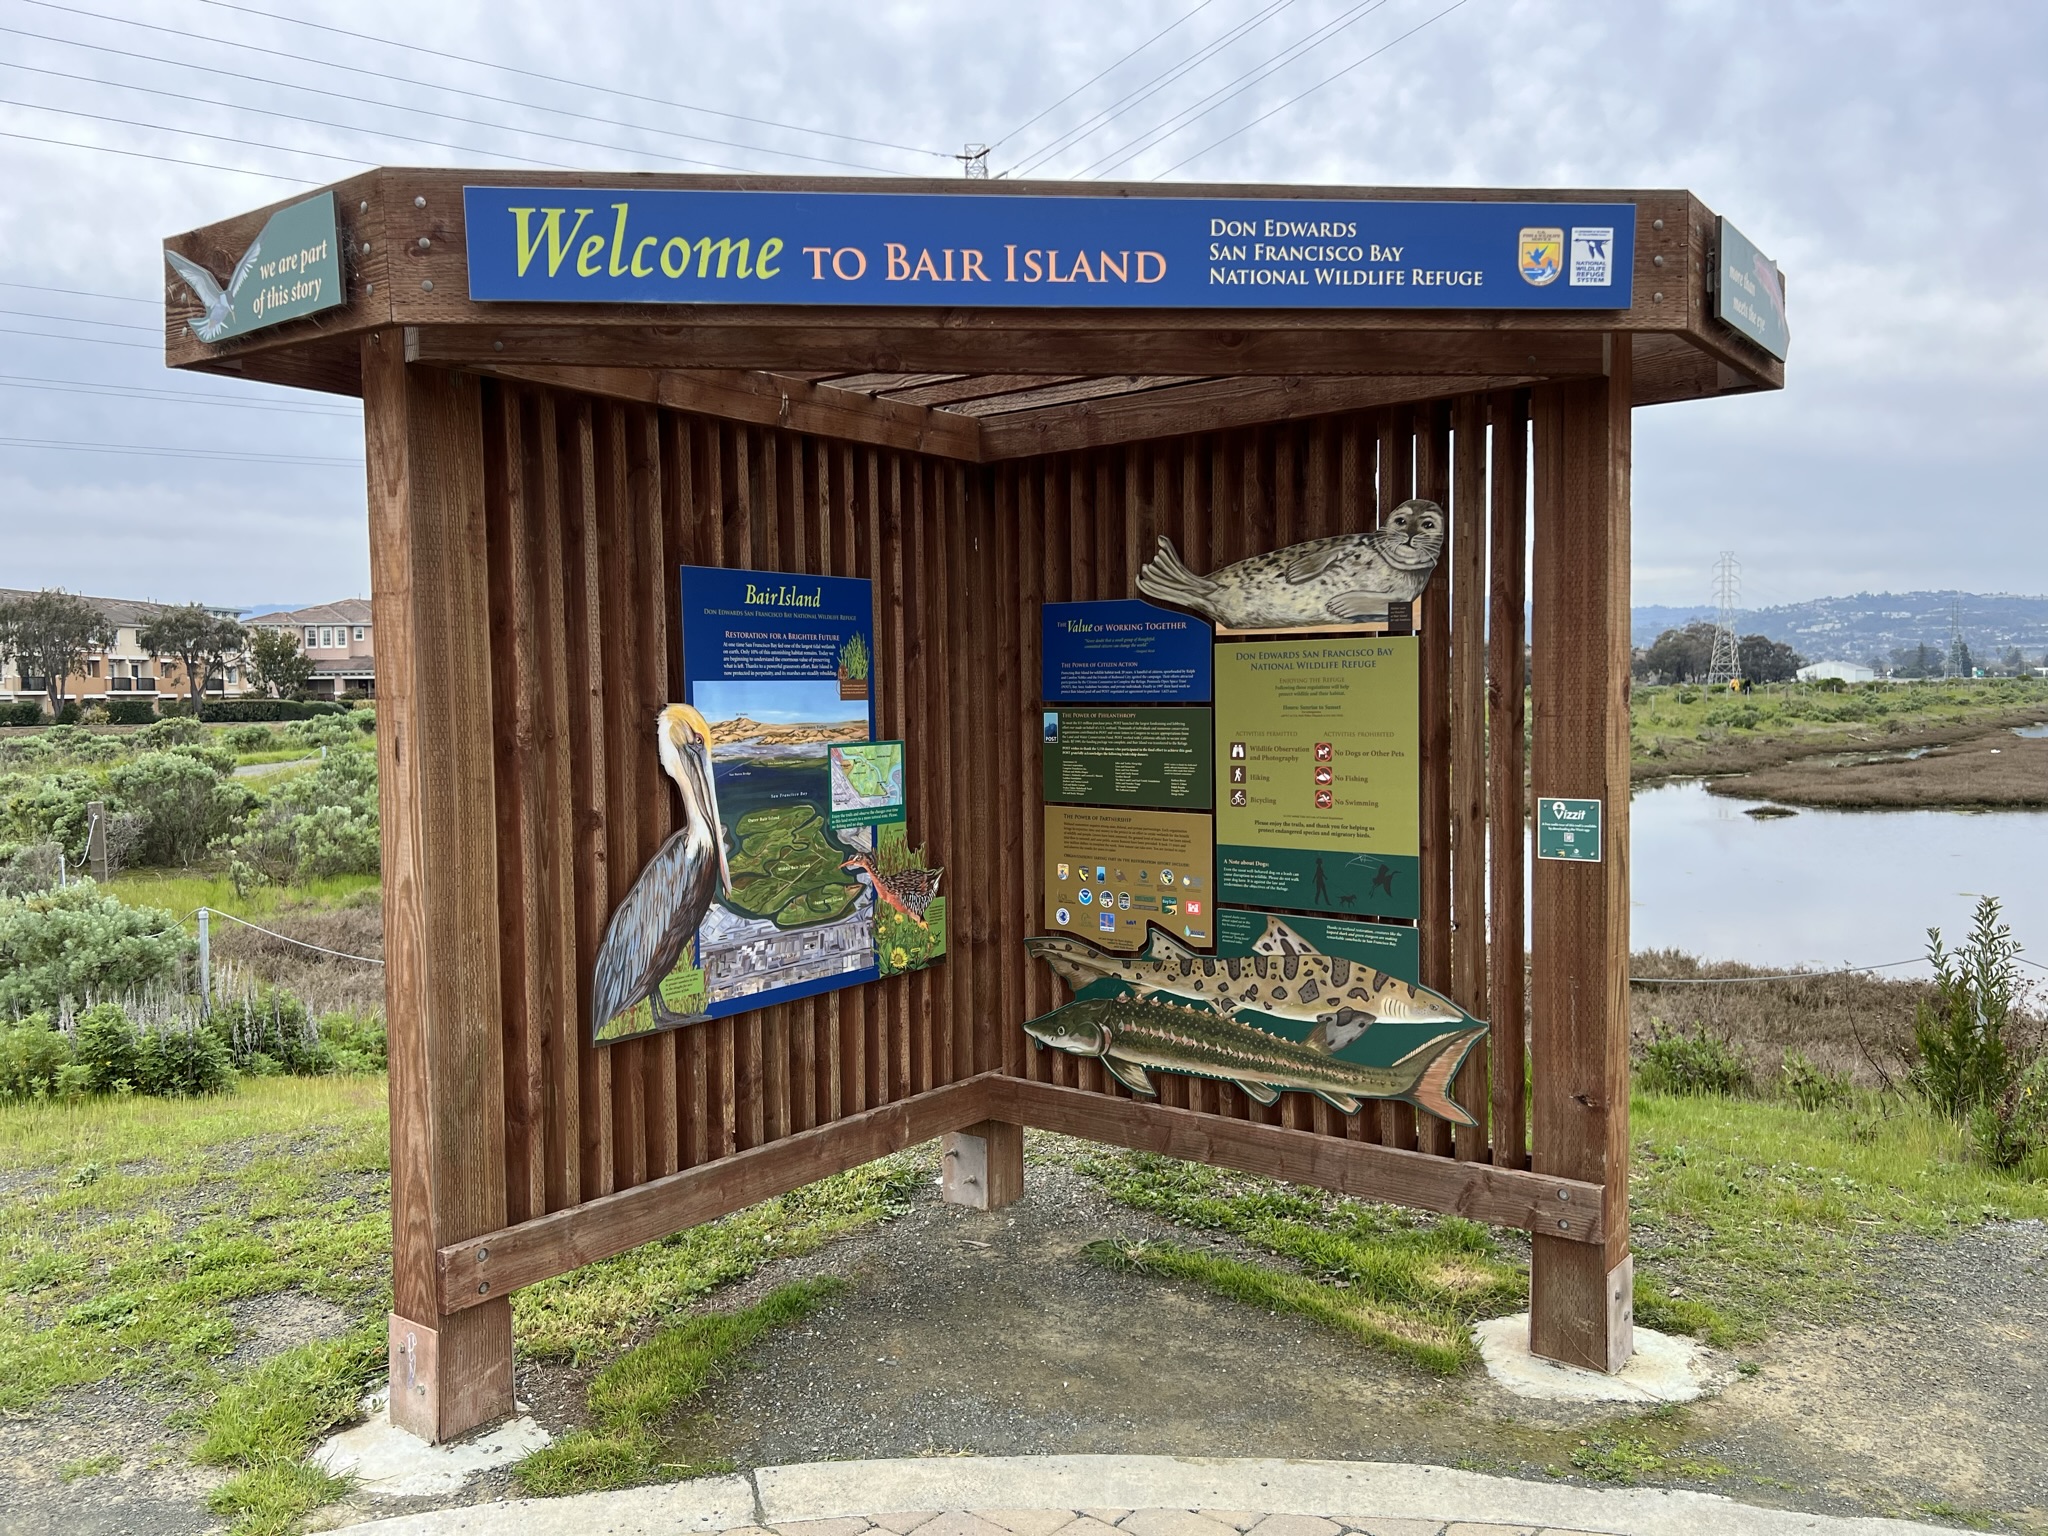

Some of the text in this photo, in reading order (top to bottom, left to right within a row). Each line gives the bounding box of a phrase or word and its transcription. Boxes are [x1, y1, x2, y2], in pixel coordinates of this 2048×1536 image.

[1209, 218, 1357, 238] DON EDWARDS
[507, 202, 1167, 284] Welcome TO BAIR ISLAND
[260, 239, 327, 280] we are part
[1209, 242, 1404, 262] SAN FRANCISCO BAY
[1209, 267, 1484, 286] NATIONAL WILDLIFE REFUGE
[253, 278, 322, 319] of this story
[744, 584, 821, 608] Bair Island
[1068, 618, 1093, 633] Value
[1145, 622, 1187, 630] TOGETHER
[725, 631, 768, 639] RESTORATION
[1236, 648, 1394, 660] DON EDWARDS SAN FRANCISCO BAY
[1251, 662, 1294, 671] NATIONAL
[1342, 660, 1376, 668] REFUGE
[1250, 797, 1276, 805] Bicycling
[1345, 799, 1379, 808] Swimming
[1553, 807, 1586, 820] Vizzit
